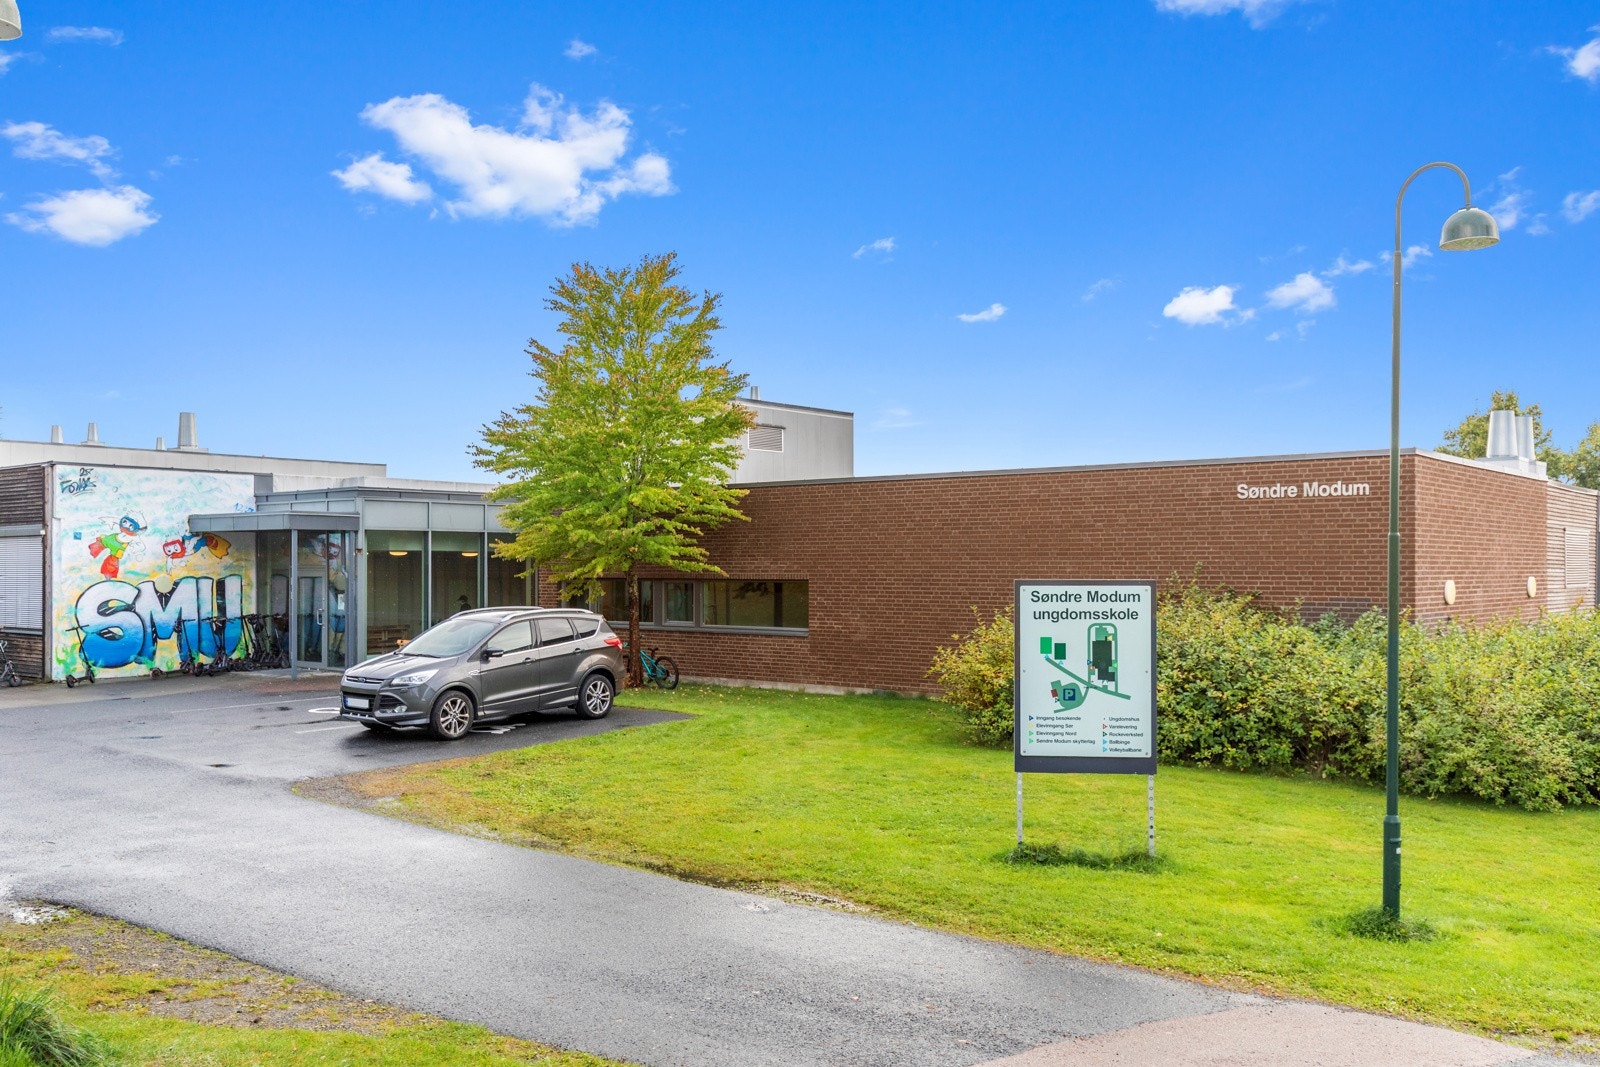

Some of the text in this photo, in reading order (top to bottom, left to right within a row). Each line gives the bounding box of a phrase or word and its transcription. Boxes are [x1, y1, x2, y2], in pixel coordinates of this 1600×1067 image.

[1237, 481, 1370, 499] Søndre Modum
[1031, 590, 1141, 603] Søndre Modum
[75, 573, 243, 668] SMU
[1033, 608, 1139, 623] ungdomsskole
